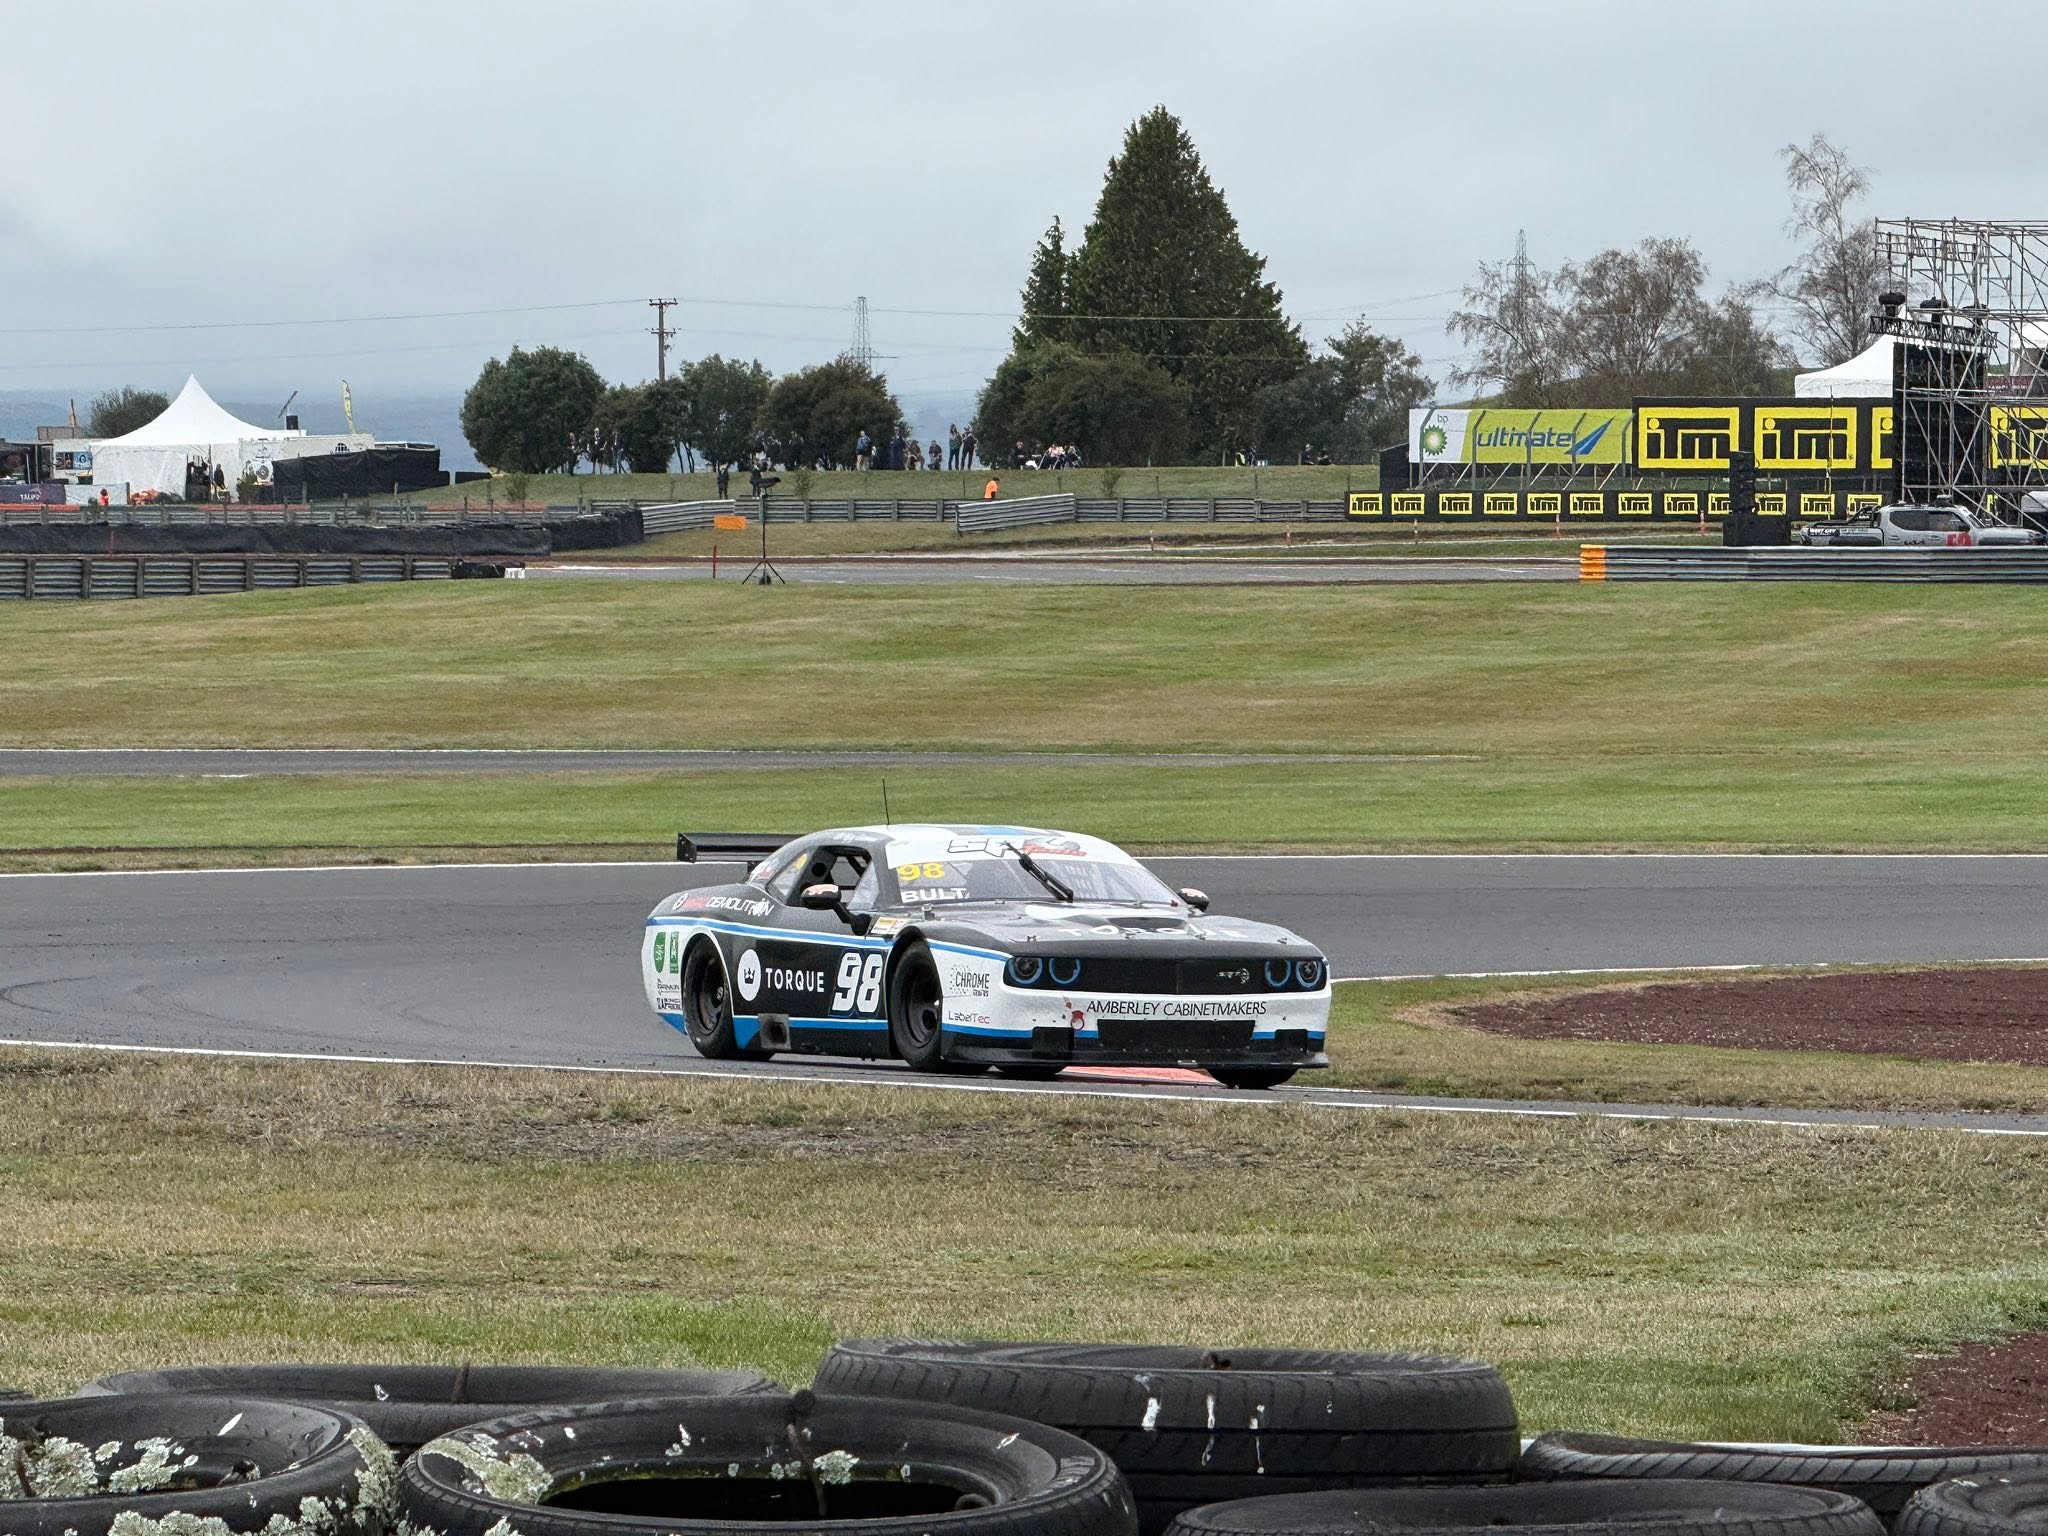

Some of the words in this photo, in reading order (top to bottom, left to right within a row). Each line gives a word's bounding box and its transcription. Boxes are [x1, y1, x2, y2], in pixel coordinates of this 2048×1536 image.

[1437, 414, 1449, 424] bp
[1476, 426, 1573, 448] ultimate
[899, 862, 945, 881] 98
[765, 967, 825, 993] TORQUE
[831, 952, 883, 1013] 98
[955, 971, 990, 989] CHROME
[1086, 1001, 1160, 1016] AMBERLEY
[1163, 1001, 1267, 1016] CABINETMAKERS
